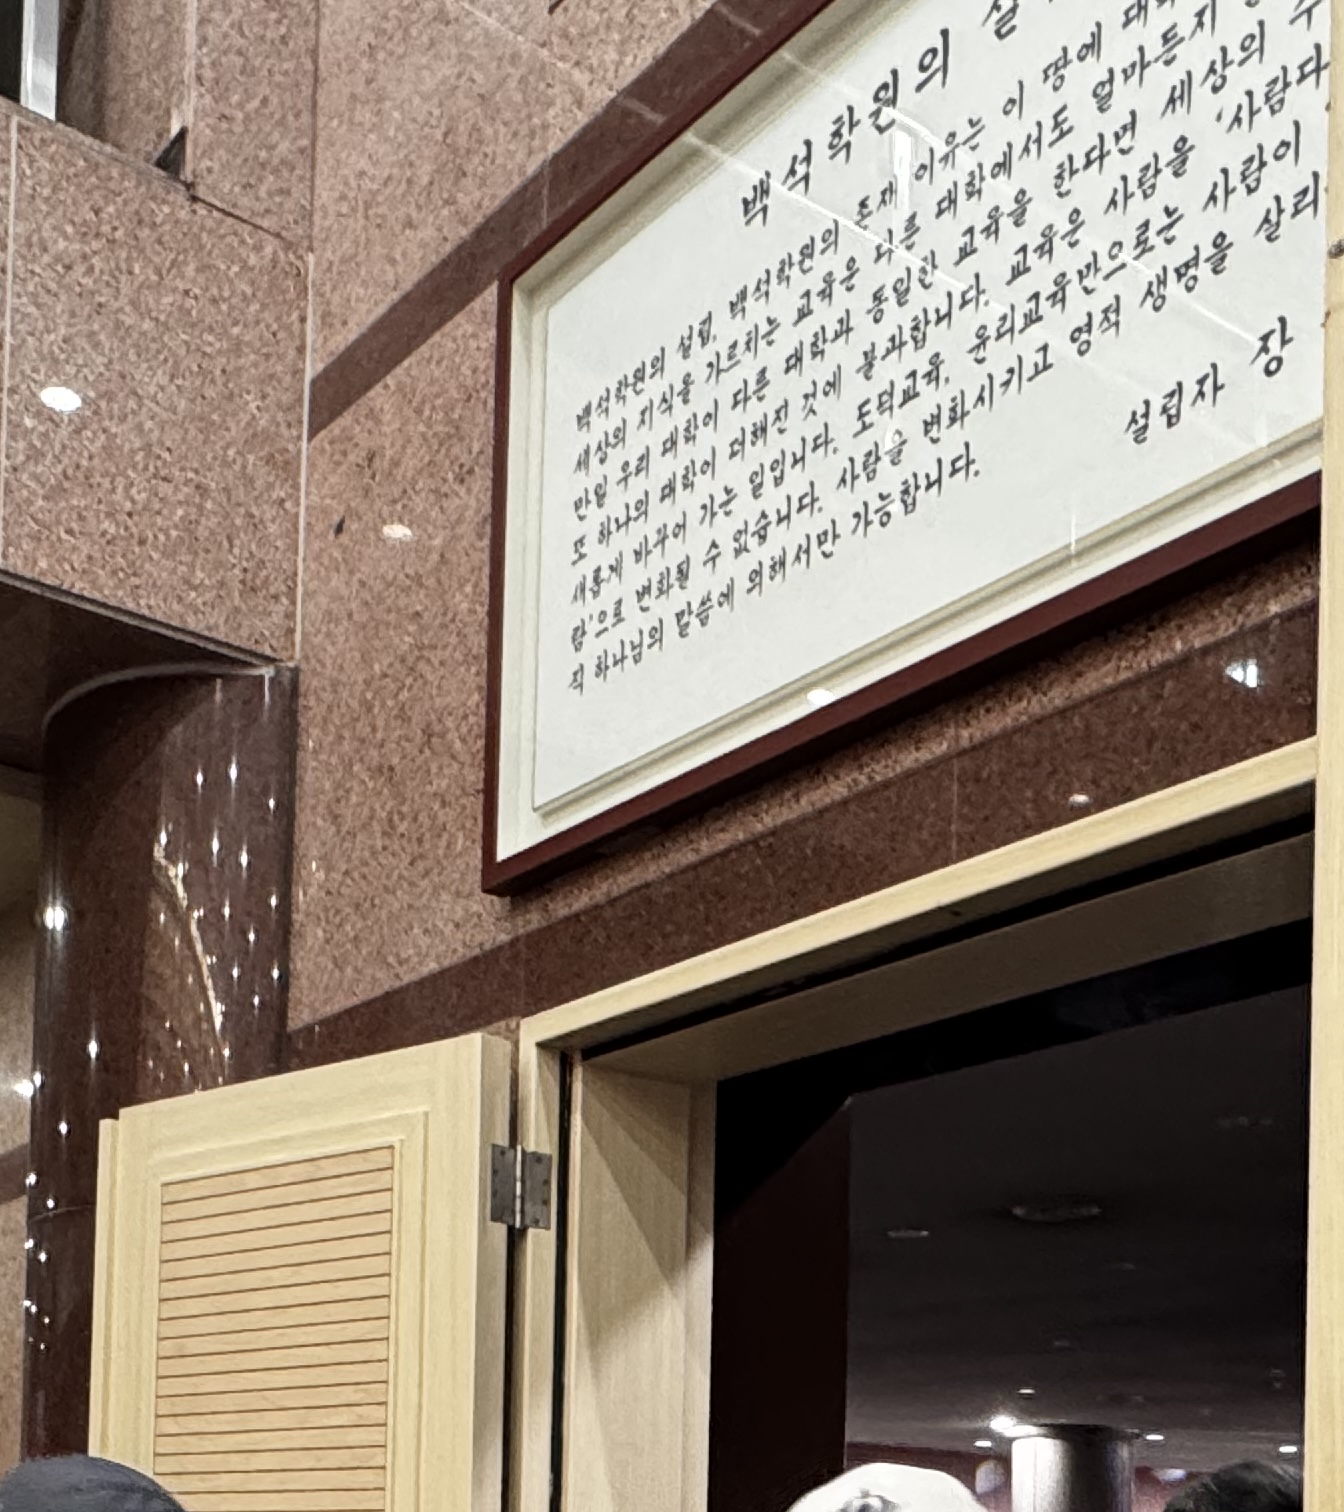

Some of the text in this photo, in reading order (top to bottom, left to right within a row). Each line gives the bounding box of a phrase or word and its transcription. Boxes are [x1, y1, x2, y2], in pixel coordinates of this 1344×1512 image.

[573, 416, 627, 477] 세상의
[637, 372, 695, 431] 지식을
[705, 315, 781, 385] 가르치는
[792, 255, 860, 327] 교육은
[935, 103, 1074, 220] 대학에서도
[1092, 0, 1216, 114] 얼마든지
[573, 474, 608, 522] 만일
[615, 445, 650, 492] 우리
[660, 397, 719, 460] 대학이
[731, 366, 771, 414] 다른
[784, 308, 854, 377] 대학과
[866, 249, 939, 325] 동일한
[952, 187, 1033, 268] 교육을
[1053, 109, 1138, 199] 한다면
[1159, 19, 1265, 120] 세상의
[576, 346, 665, 432] 백석학원의
[729, 218, 839, 320] 백석학원의
[914, 116, 986, 185] 이유는
[1002, 79, 1024, 121] 이
[1042, 20, 1102, 92] 땅에
[742, 28, 950, 227] 백석학원의
[570, 534, 588, 567] 또
[597, 489, 650, 548] 하나의
[659, 445, 716, 505] 대학이
[728, 397, 789, 462] 더해진
[802, 363, 842, 421] 것에
[855, 272, 990, 381] 불과합니다.
[1005, 207, 1086, 287] 교육은
[1103, 134, 1196, 216] 사람을
[570, 550, 623, 606] 새롭게
[632, 510, 687, 569] 바꾸어
[699, 485, 738, 528] 가는
[748, 421, 839, 500] 일입니다.
[966, 204, 1184, 364] 윤리교육만으로는
[1202, 119, 1302, 213] 사람이
[635, 553, 691, 612] 변화될
[703, 539, 722, 576] 수
[732, 480, 823, 560] 없습니다.
[836, 429, 908, 494] 사람을
[922, 342, 1054, 444] 변화시키고
[1069, 294, 1122, 357] 영적
[1139, 230, 1234, 312] 생명을
[1124, 315, 1295, 444] 설립자 장
[568, 440, 980, 696] 직 하나님의 말씀에 의해서만 가능합니다.
